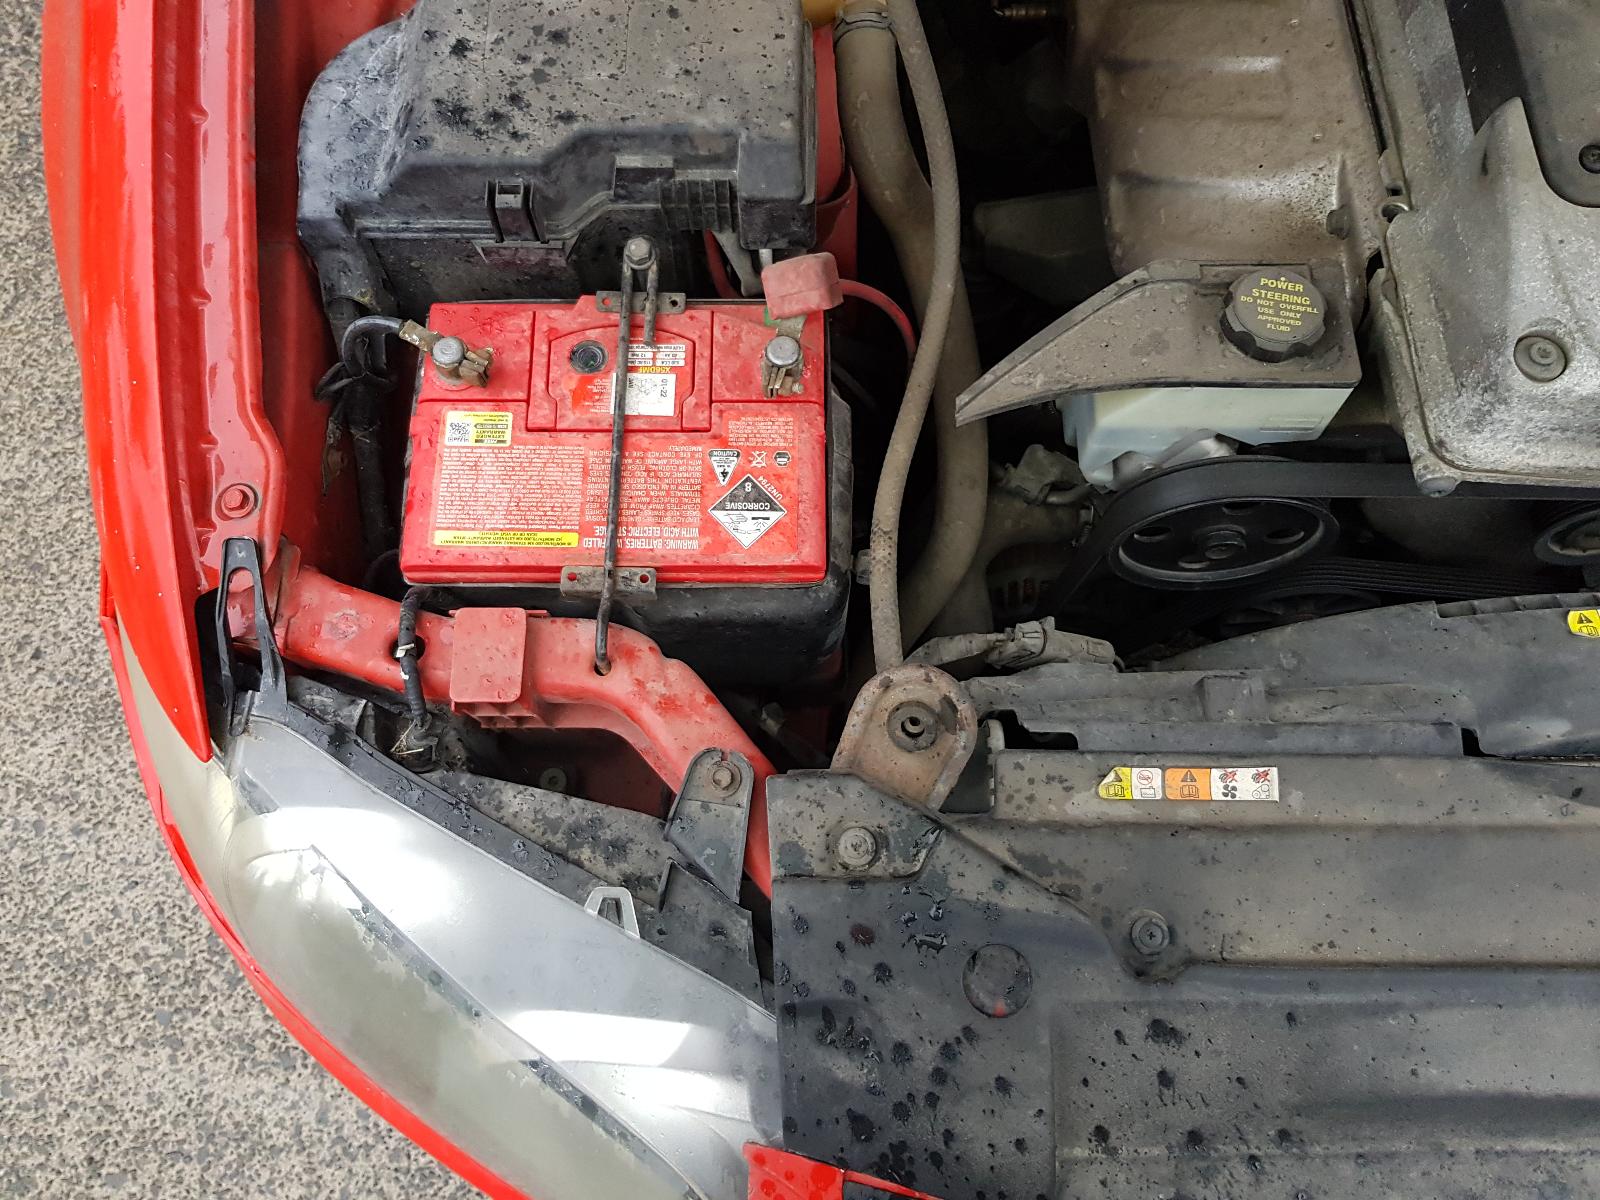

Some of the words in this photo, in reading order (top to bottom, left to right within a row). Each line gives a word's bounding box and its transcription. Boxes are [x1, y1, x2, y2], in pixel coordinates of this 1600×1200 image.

[1260, 278, 1303, 292] POWER
[1252, 288, 1310, 304] STEERING
[1258, 306, 1274, 314] USE
[1280, 310, 1302, 318] ONLY
[1280, 303, 1319, 314] OVERFILL
[1258, 314, 1302, 326] APPROVED
[1267, 324, 1290, 332] FLUID
[745, 482, 752, 492] 8
[628, 526, 660, 536] ELECTRIC
[682, 527, 699, 537] WITH
[583, 538, 606, 548] FILLED
[624, 538, 663, 549] BATTERIES,
[665, 539, 699, 550] WARNING:
